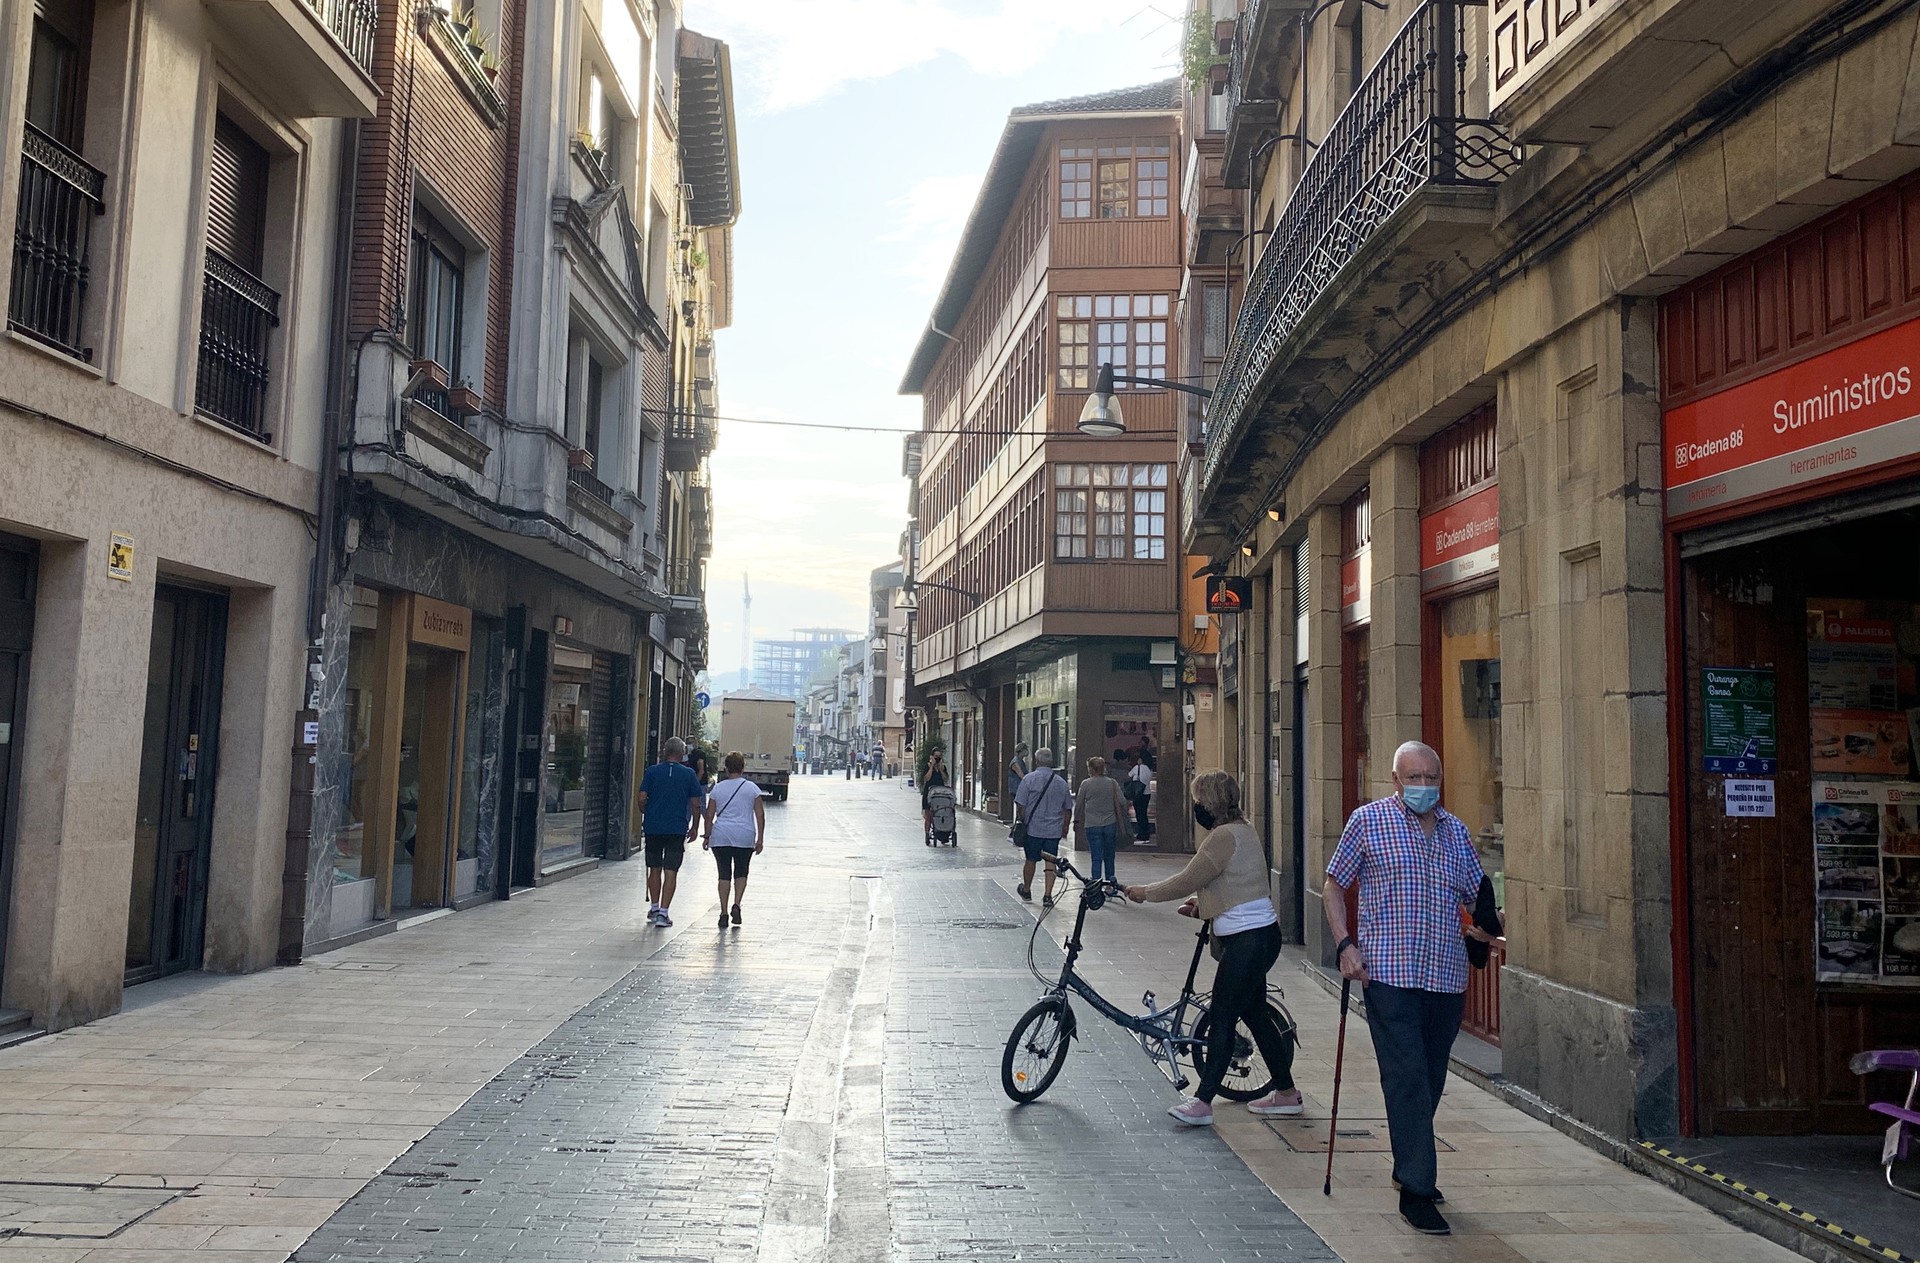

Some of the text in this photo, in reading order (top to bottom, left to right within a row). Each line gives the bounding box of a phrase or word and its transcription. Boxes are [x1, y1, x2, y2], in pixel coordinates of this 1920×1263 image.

[1773, 366, 1911, 433] Suministros
[1790, 446, 1857, 474] herramientas
[423, 610, 463, 636] Zubizarreta
[1844, 626, 1892, 637] PALMERA
[1707, 672, 1739, 688] Durango
[1734, 784, 1755, 792] NECESITO
[1727, 794, 1747, 803] PEQUEÑO
